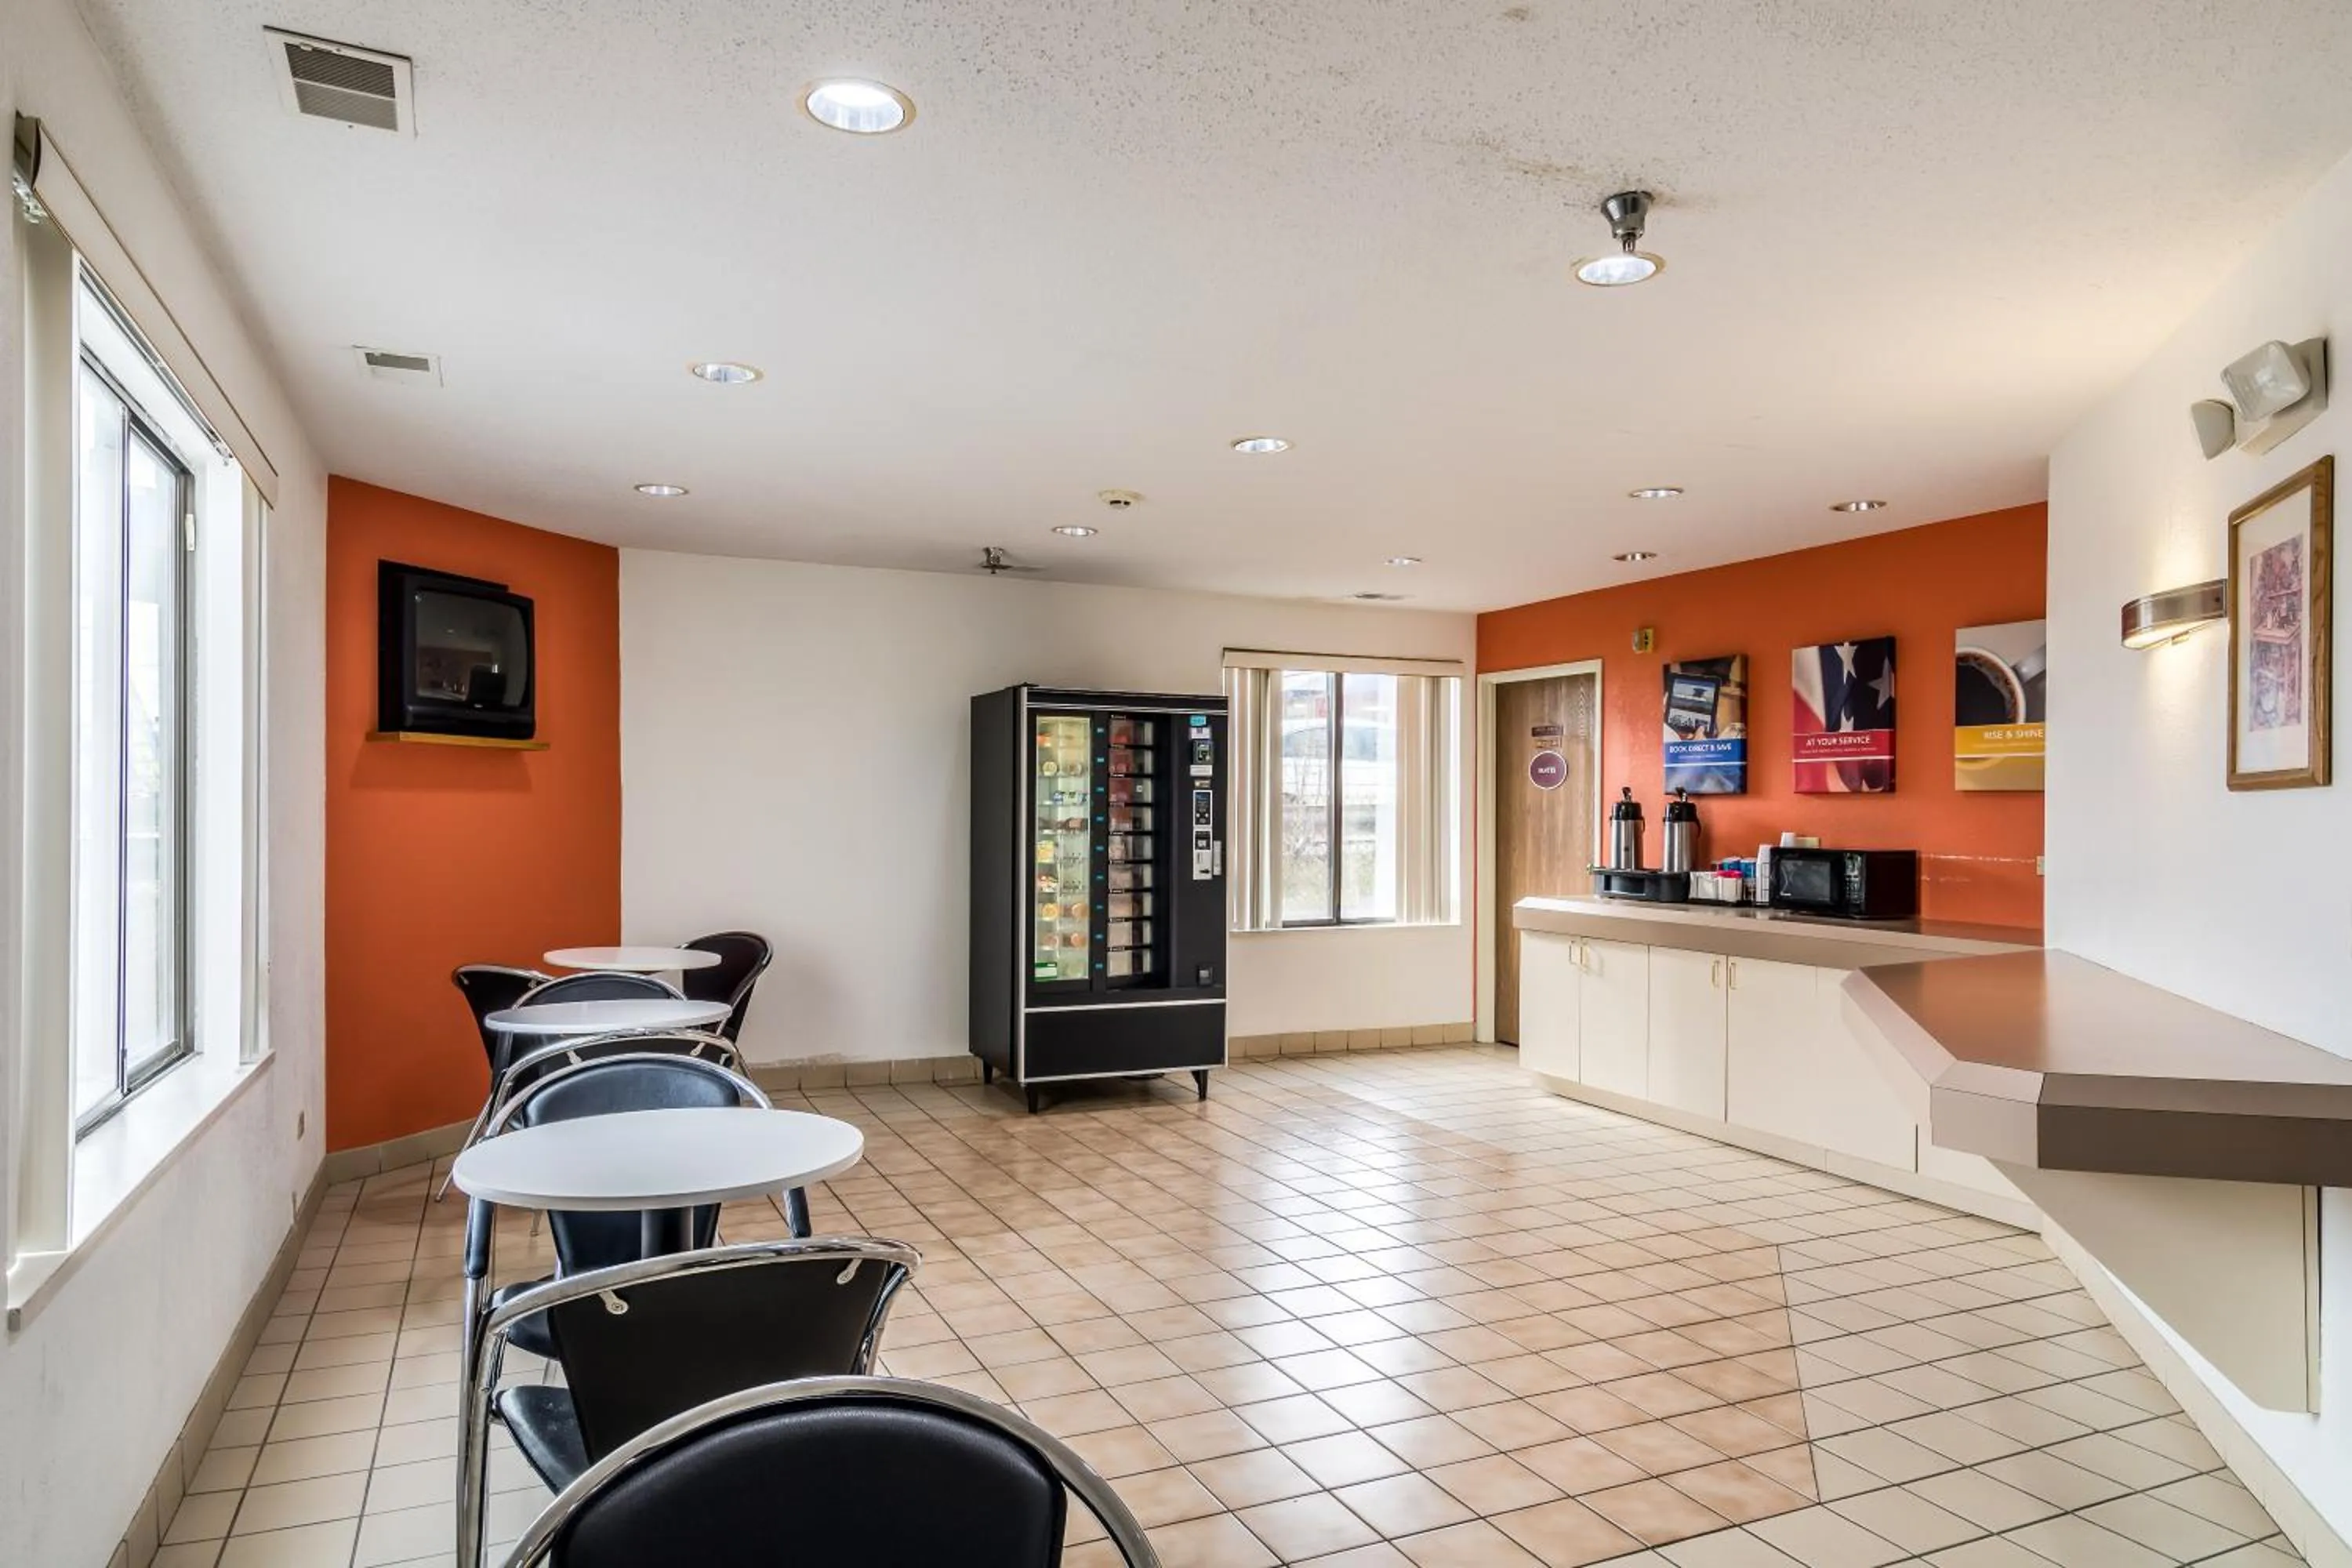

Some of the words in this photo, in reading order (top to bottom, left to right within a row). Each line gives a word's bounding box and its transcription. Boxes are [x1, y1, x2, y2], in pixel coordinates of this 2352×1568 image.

[1984, 730, 2003, 739] RISE
[1806, 738, 1816, 746] AT
[1817, 737, 1837, 746] YOUR
[1838, 735, 1871, 745] SERVICE
[1716, 742, 1732, 752] SAVE
